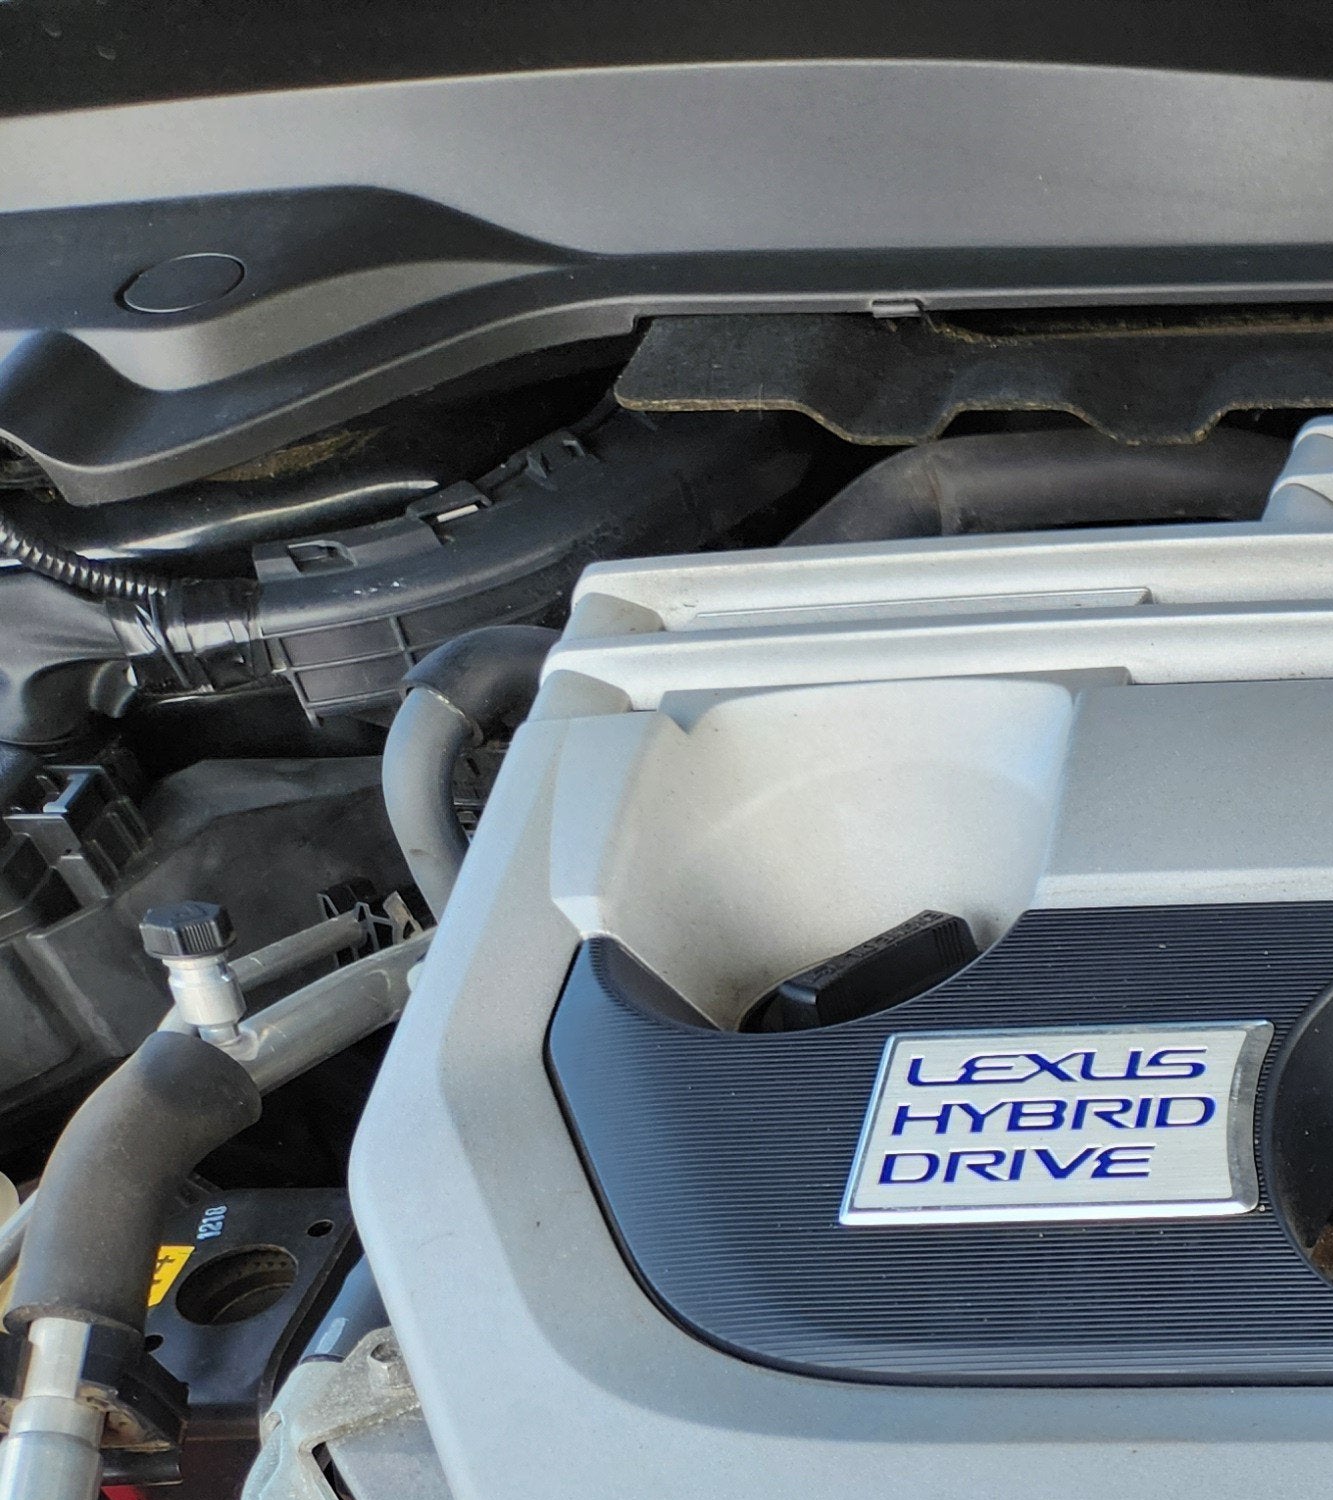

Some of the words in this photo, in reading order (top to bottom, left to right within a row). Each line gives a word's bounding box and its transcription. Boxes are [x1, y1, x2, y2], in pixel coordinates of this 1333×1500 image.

[906, 1047, 1208, 1087] LEXUS
[890, 1095, 1216, 1136] HYBRID
[878, 1143, 1157, 1185] DRIVE
